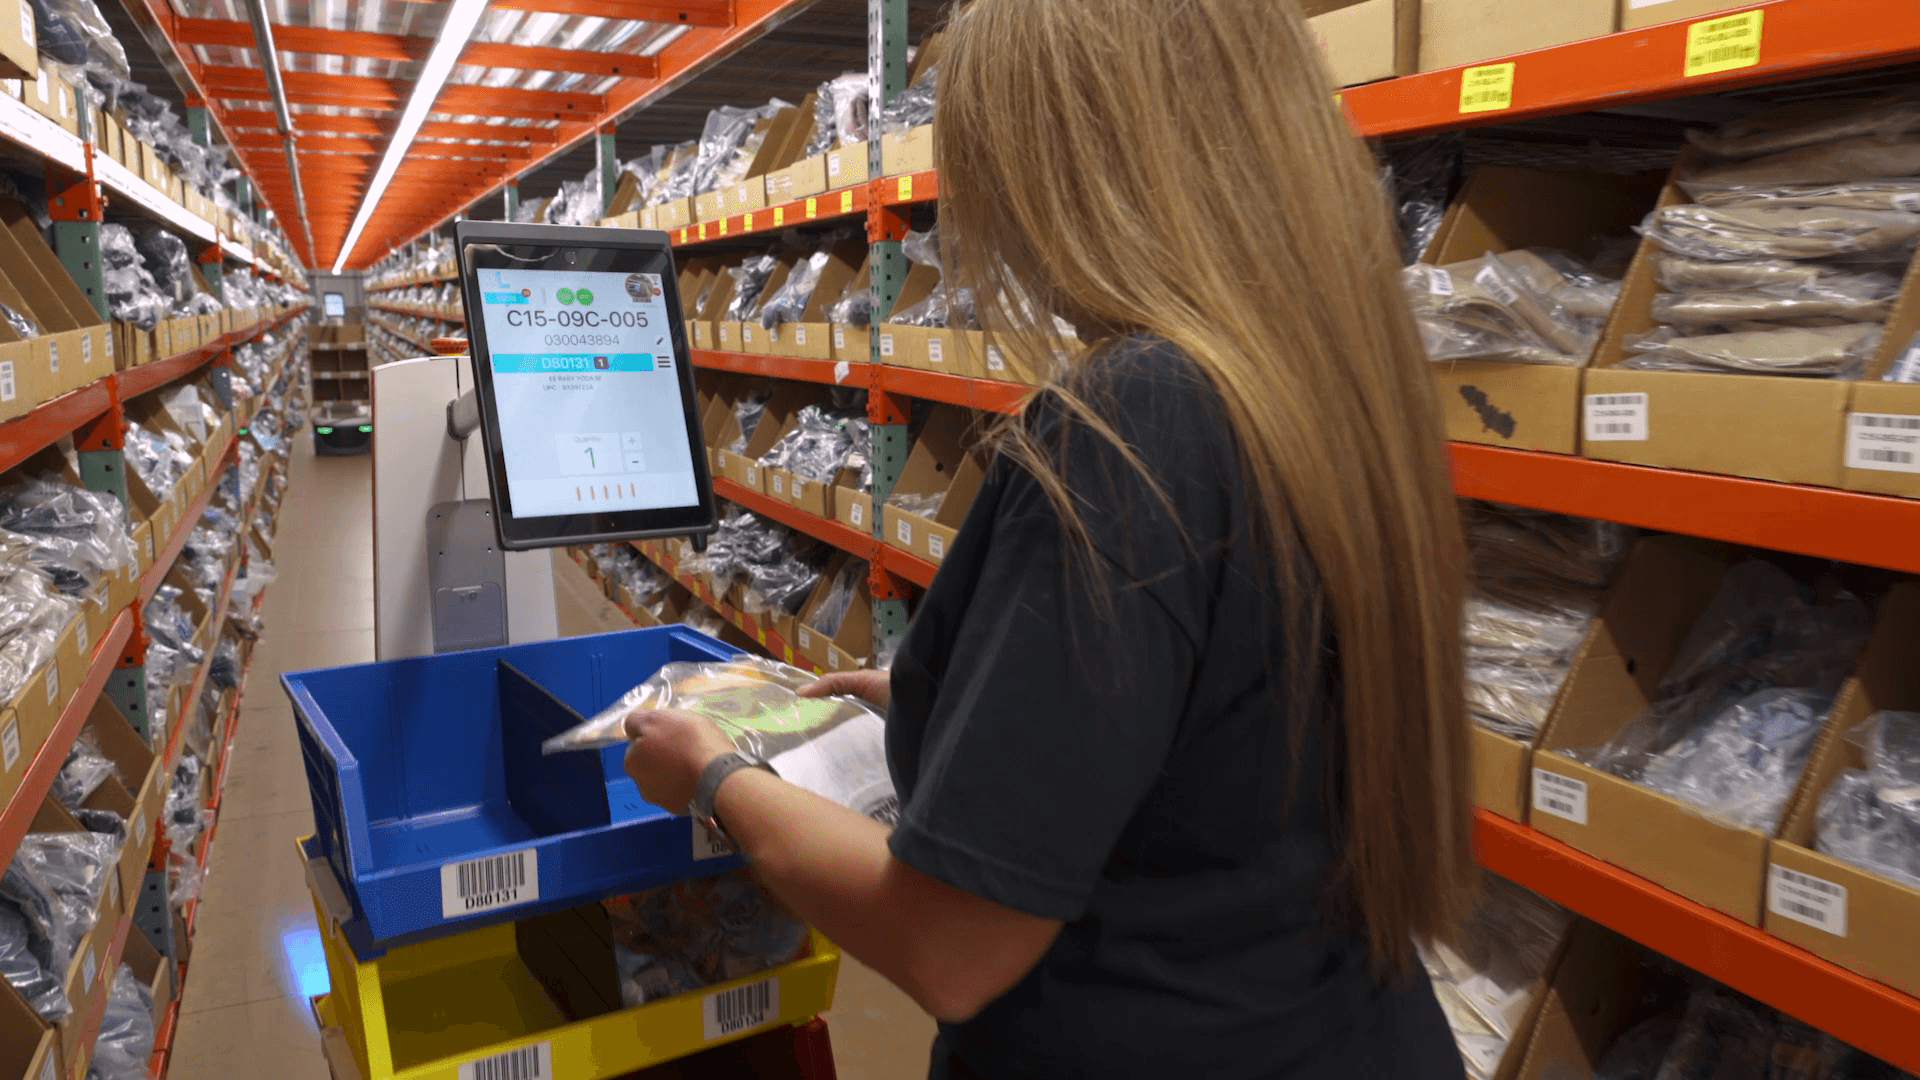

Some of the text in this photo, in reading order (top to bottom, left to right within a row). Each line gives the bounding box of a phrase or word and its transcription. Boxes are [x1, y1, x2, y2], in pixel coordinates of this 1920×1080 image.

[507, 310, 649, 328] C15-09C-005
[544, 334, 620, 346] 030043894
[541, 357, 590, 369] D80131
[584, 447, 595, 469] 1
[465, 888, 518, 910] D80131
[721, 1011, 764, 1034] D80134
